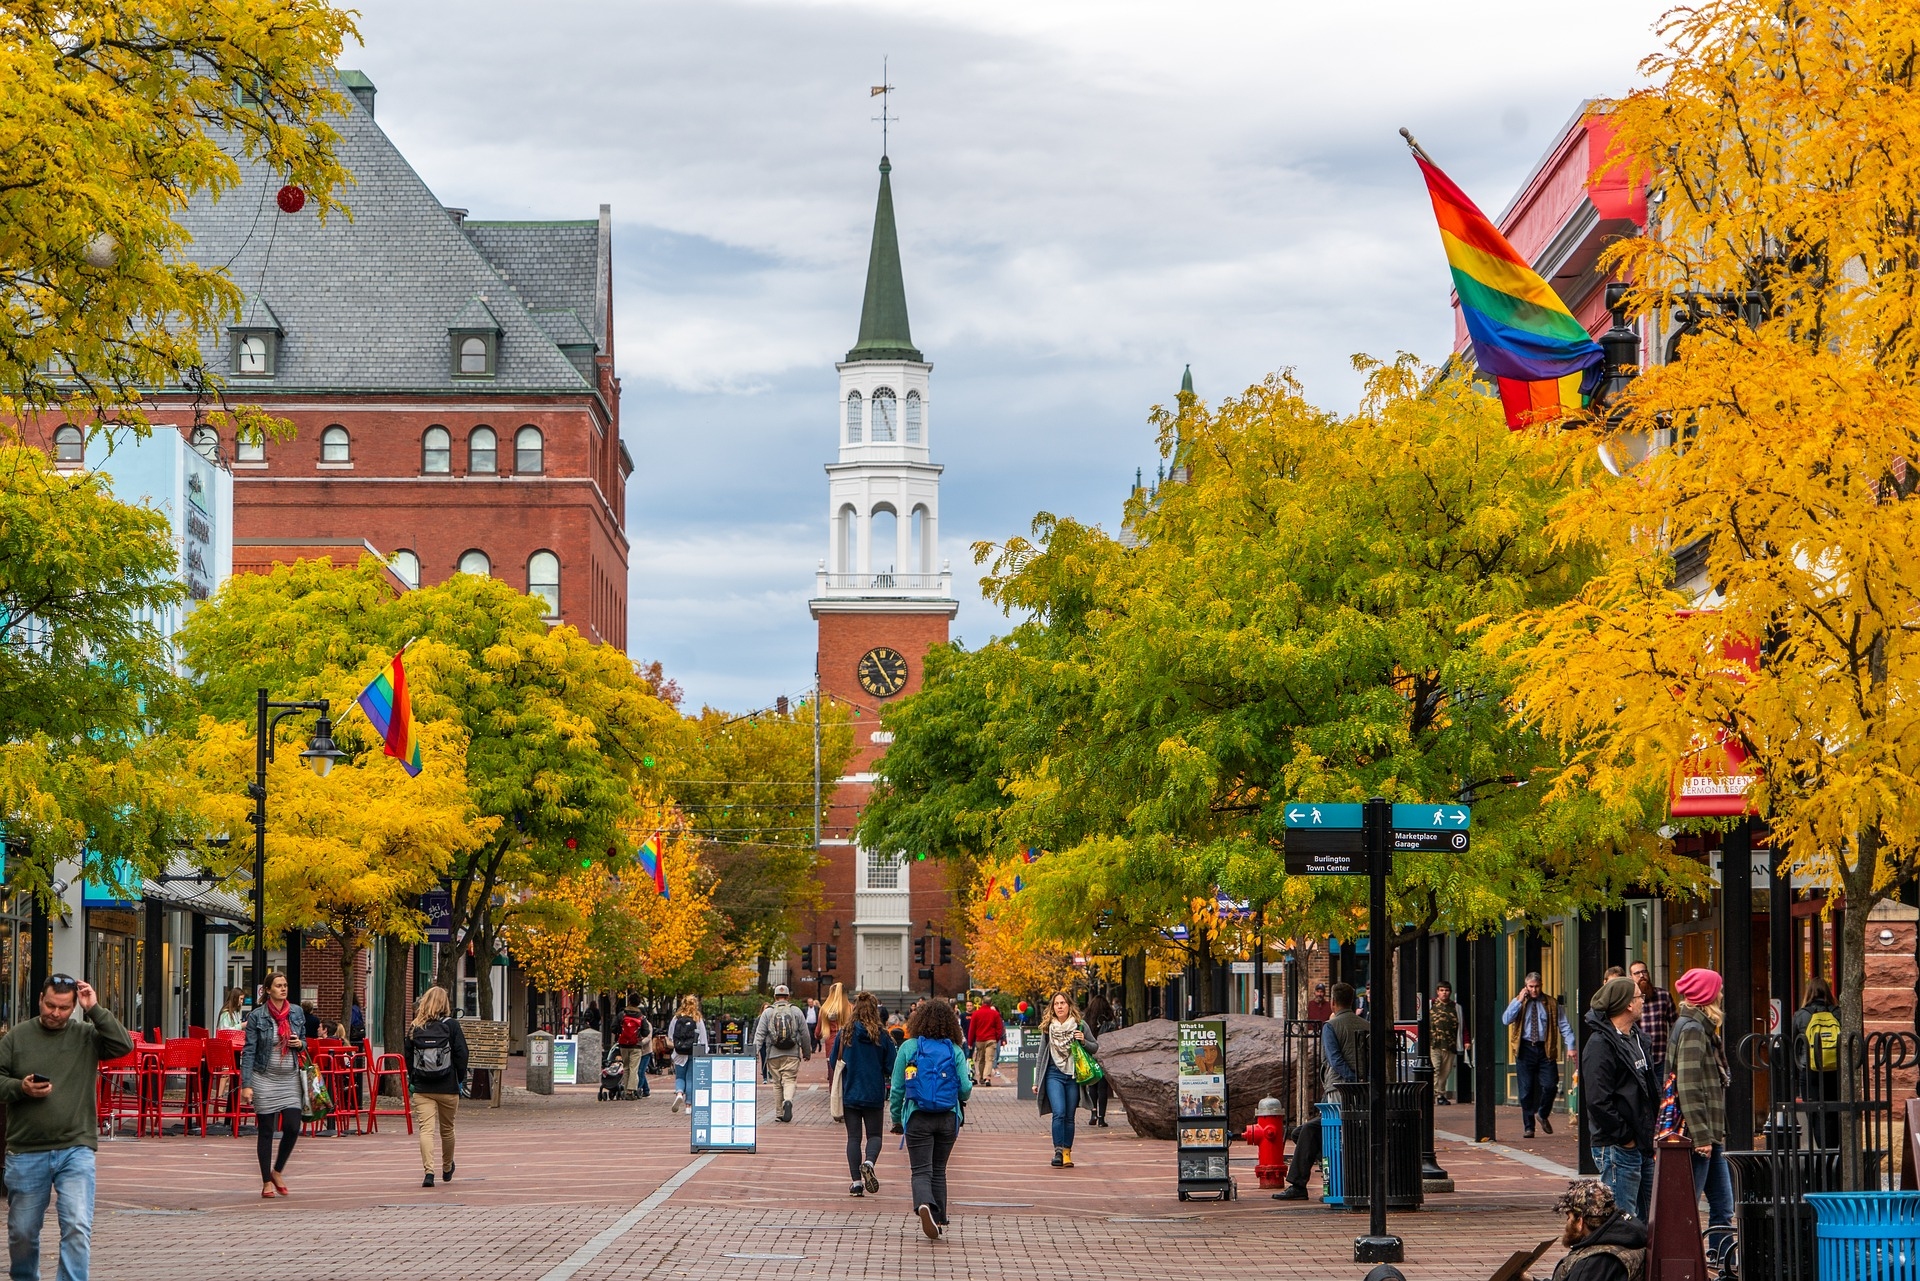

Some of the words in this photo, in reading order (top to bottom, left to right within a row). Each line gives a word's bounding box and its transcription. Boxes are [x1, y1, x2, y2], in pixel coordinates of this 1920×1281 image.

[1395, 832, 1438, 842] Marketplace
[1395, 840, 1420, 849] Garage
[1314, 855, 1351, 864] Burlington
[1326, 864, 1350, 872] Center
[426, 909, 450, 920] OCAL
[1180, 1029, 1216, 1039] True
